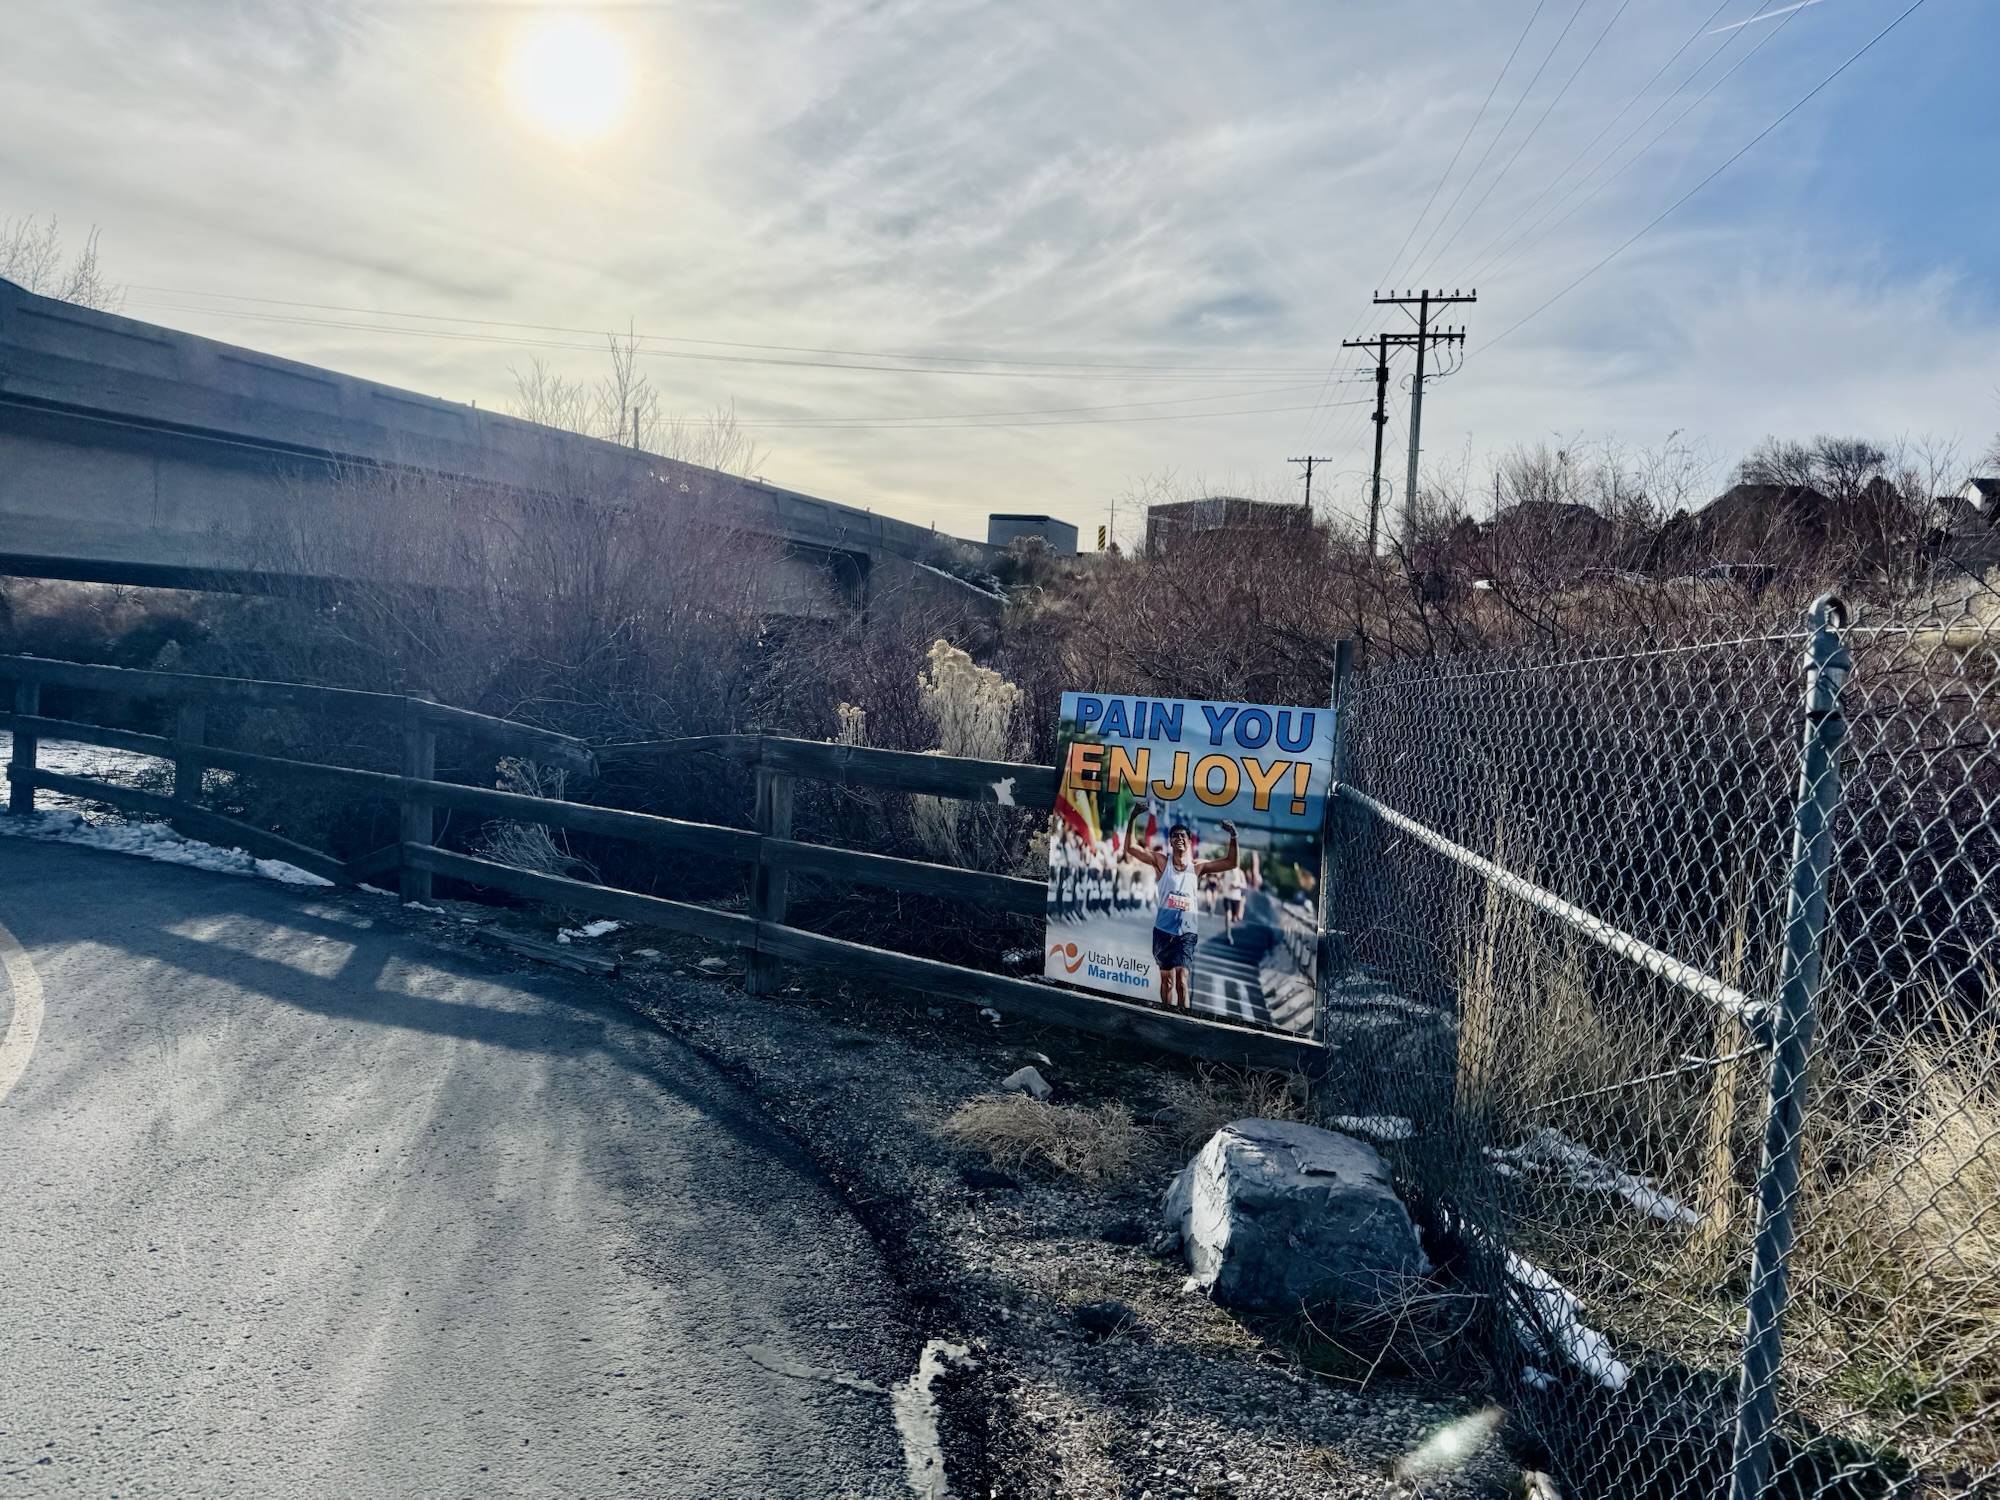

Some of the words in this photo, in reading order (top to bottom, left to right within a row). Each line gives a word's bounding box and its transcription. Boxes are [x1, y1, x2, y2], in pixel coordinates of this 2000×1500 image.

[1075, 697, 1184, 742] PAIN
[1201, 705, 1315, 753] YOU
[1069, 742, 1312, 816] ENJOY!
[1088, 951, 1114, 966] Utah
[1116, 956, 1150, 975] Valley
[1088, 964, 1149, 988] Marathon
